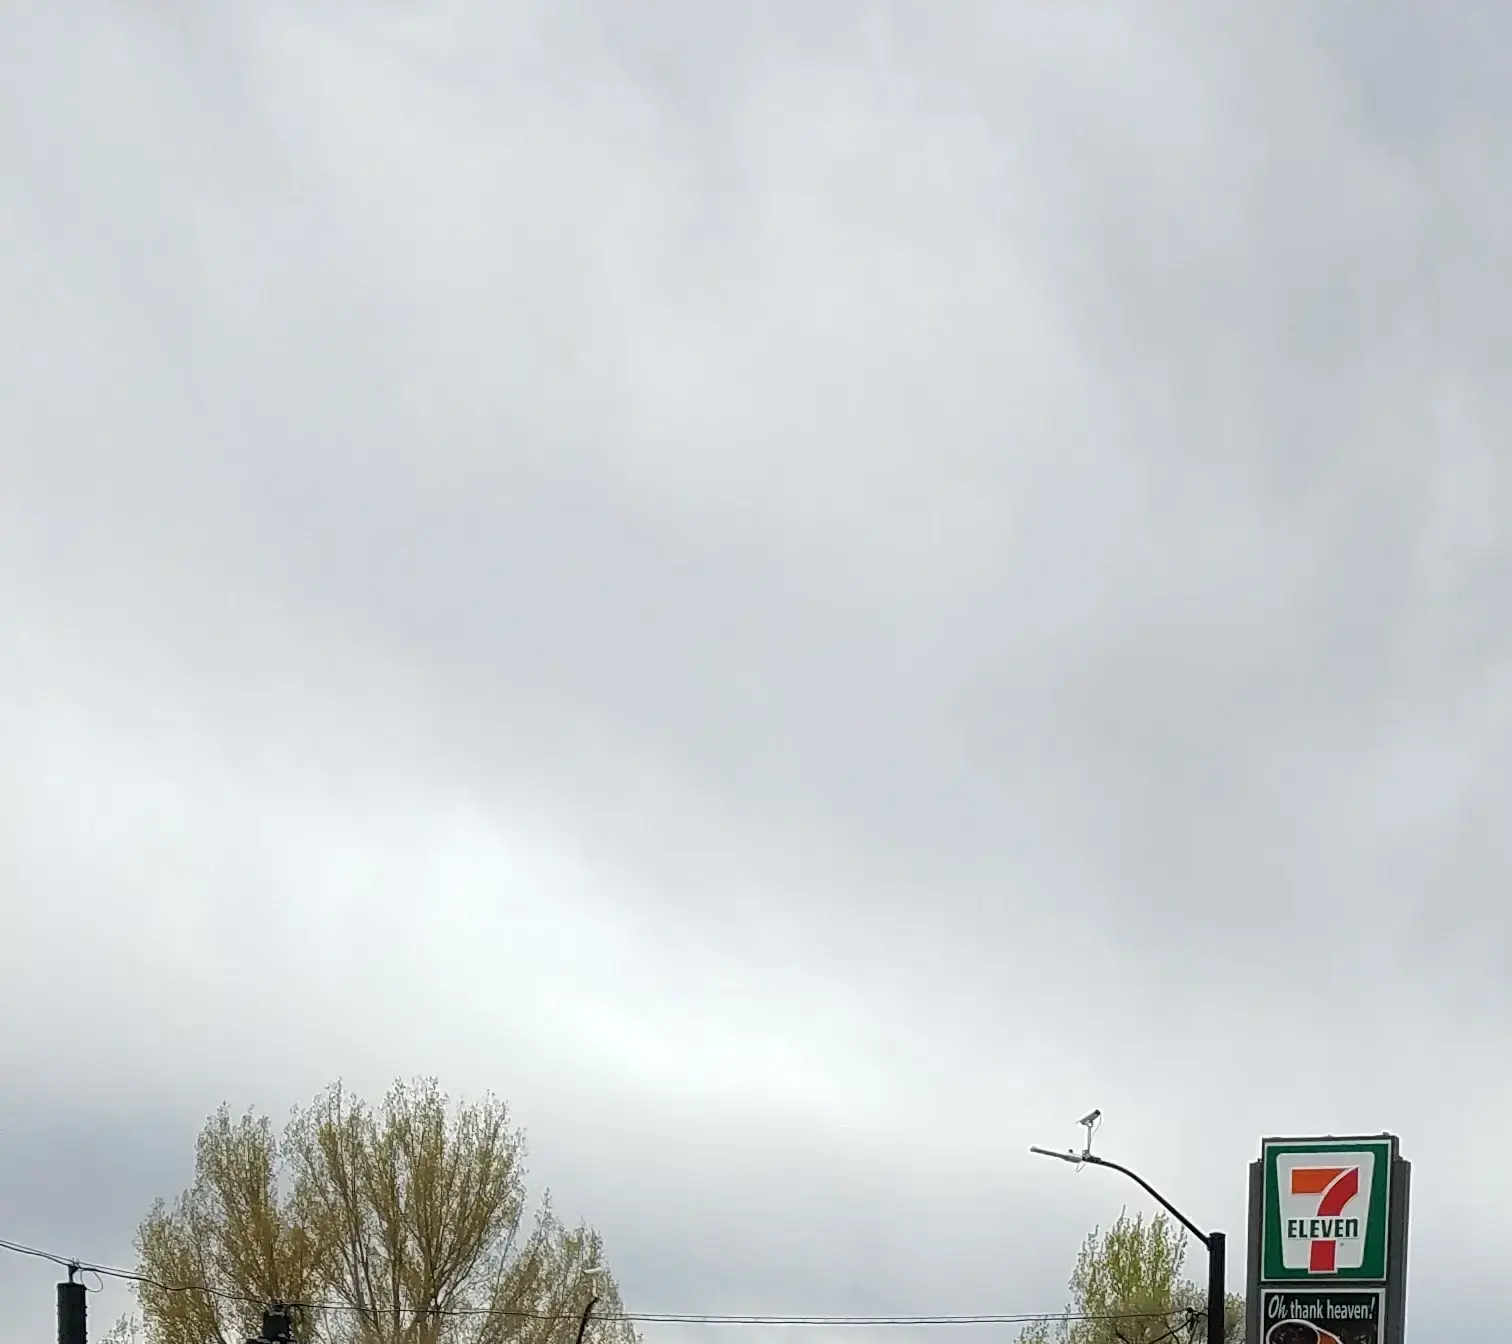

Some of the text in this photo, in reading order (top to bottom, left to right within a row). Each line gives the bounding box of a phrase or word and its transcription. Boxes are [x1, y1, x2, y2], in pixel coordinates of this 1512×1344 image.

[1291, 1166, 1359, 1272] 7
[1268, 1294, 1376, 1320] Oh thank heaven!
